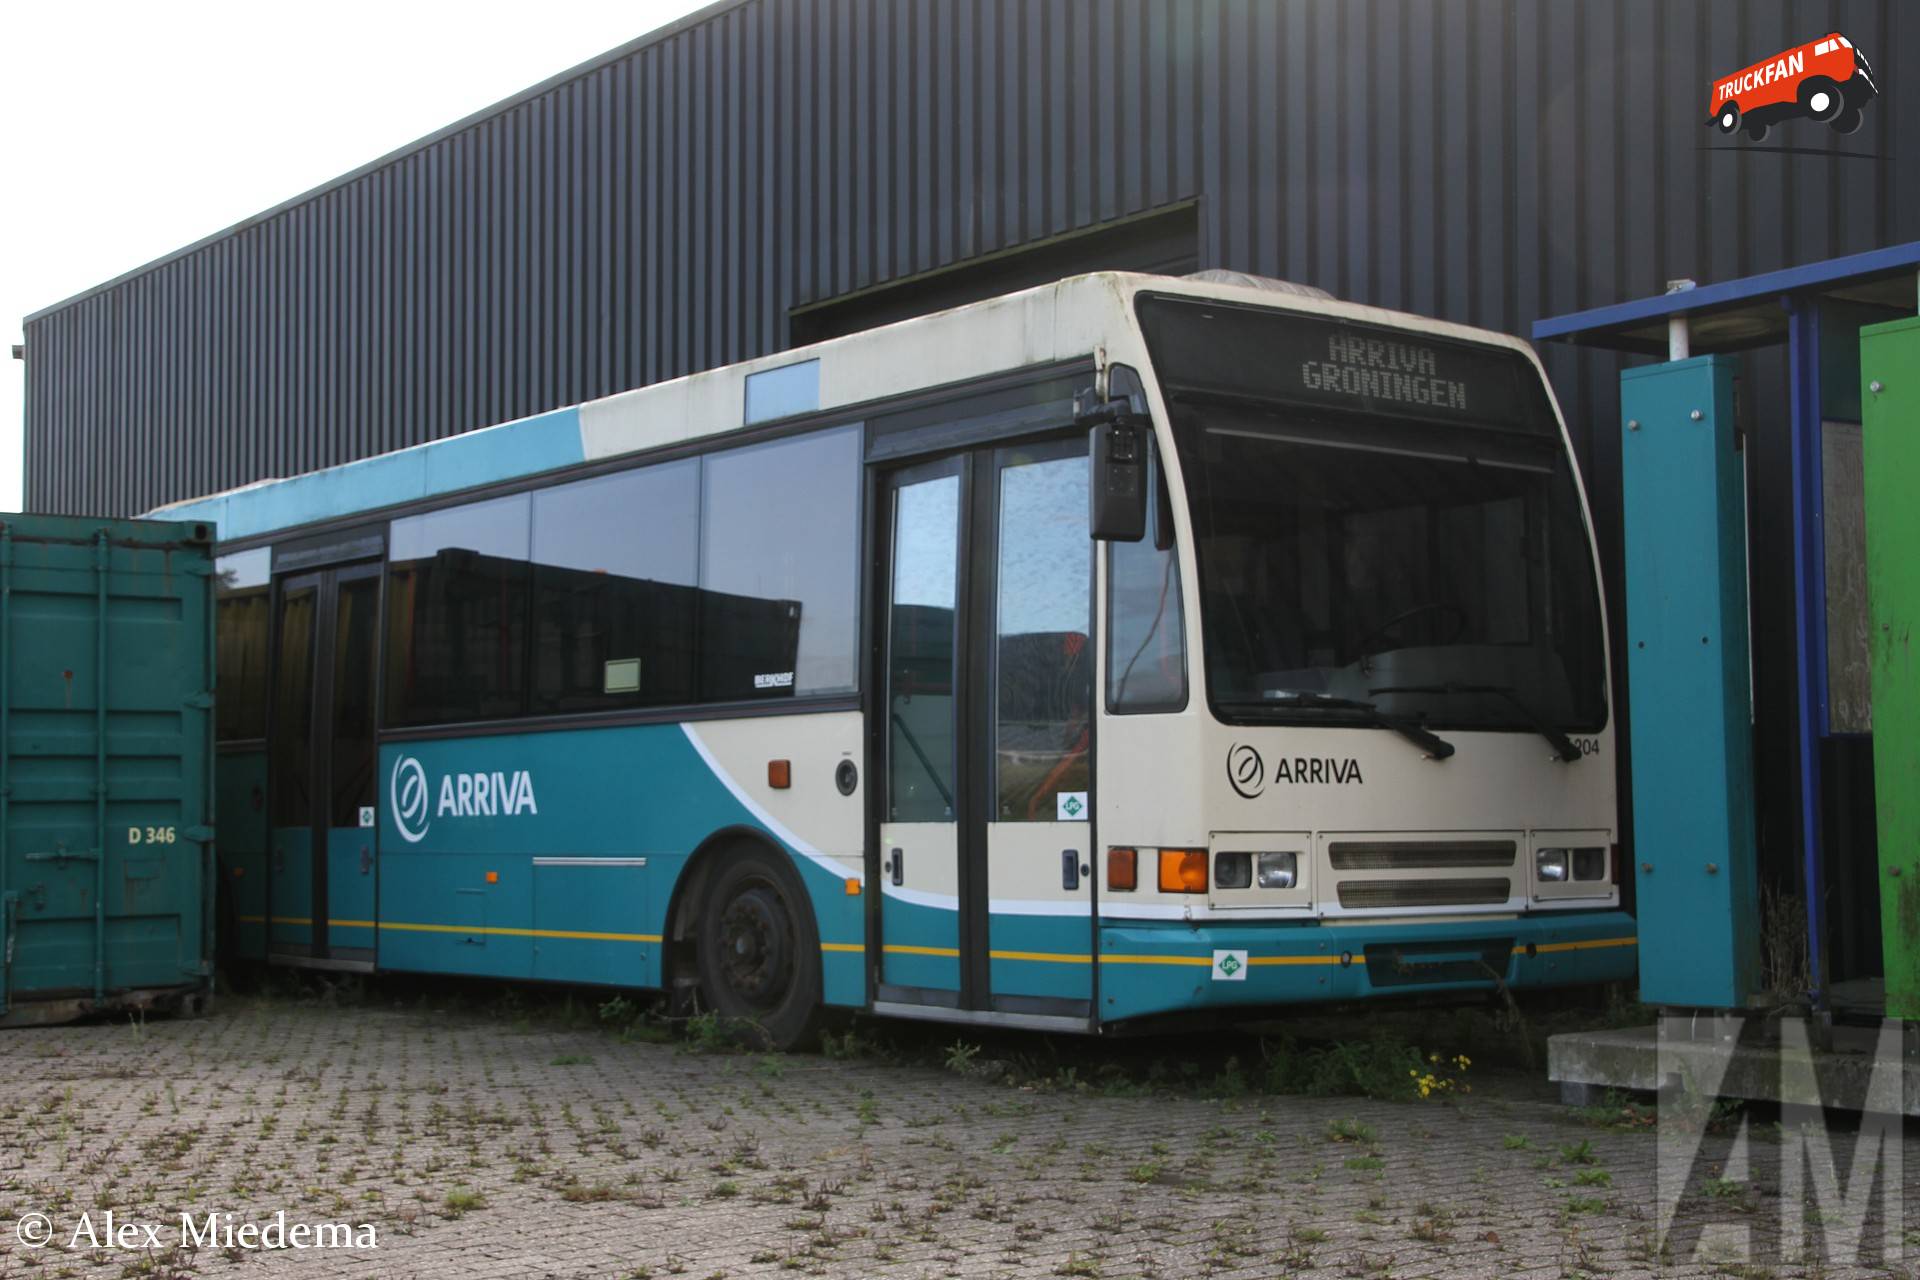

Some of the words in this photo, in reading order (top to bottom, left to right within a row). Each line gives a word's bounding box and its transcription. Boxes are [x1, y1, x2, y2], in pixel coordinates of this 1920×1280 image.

[1329, 334, 1436, 376] ARRIVA
[1303, 361, 1466, 409] GRONINGEN
[1275, 757, 1363, 784] ARRIVA
[438, 771, 538, 817] ARRIVA
[128, 827, 141, 844] D
[145, 827, 175, 844] 346
[1221, 960, 1237, 970] LPG
